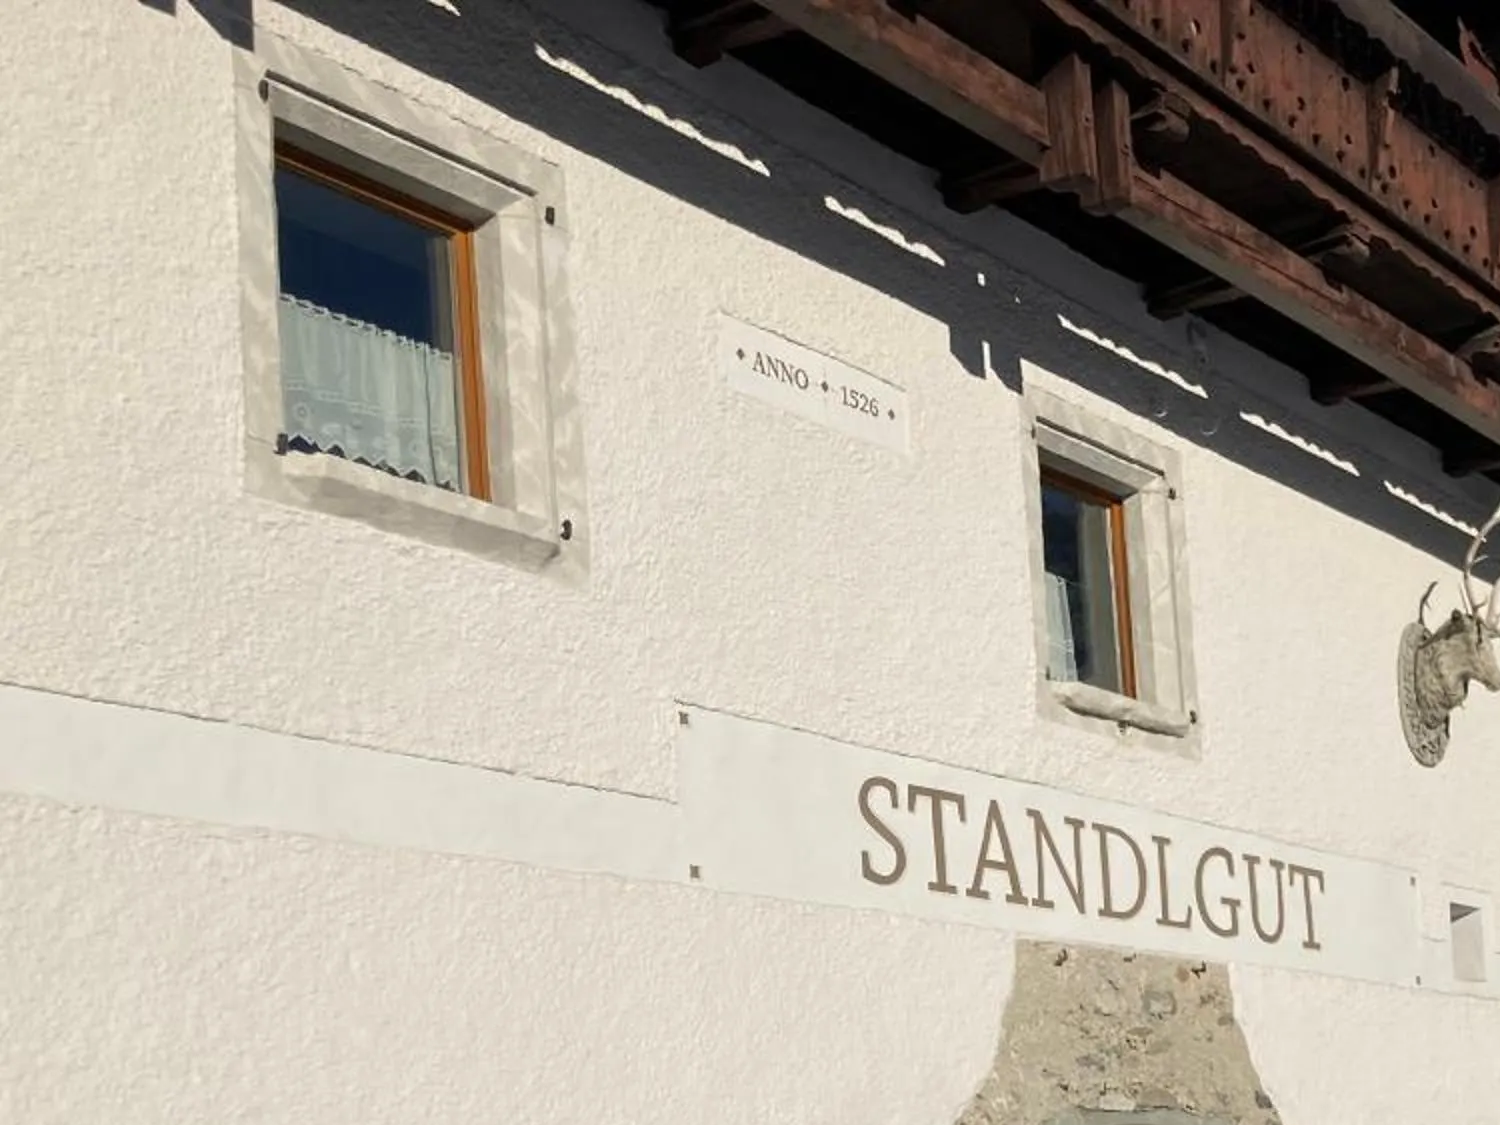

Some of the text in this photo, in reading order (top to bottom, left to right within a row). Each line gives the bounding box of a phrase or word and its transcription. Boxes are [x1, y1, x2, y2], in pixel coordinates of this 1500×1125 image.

[752, 351, 880, 417] ANNO 1526
[858, 775, 1326, 951] STANDLGUT
